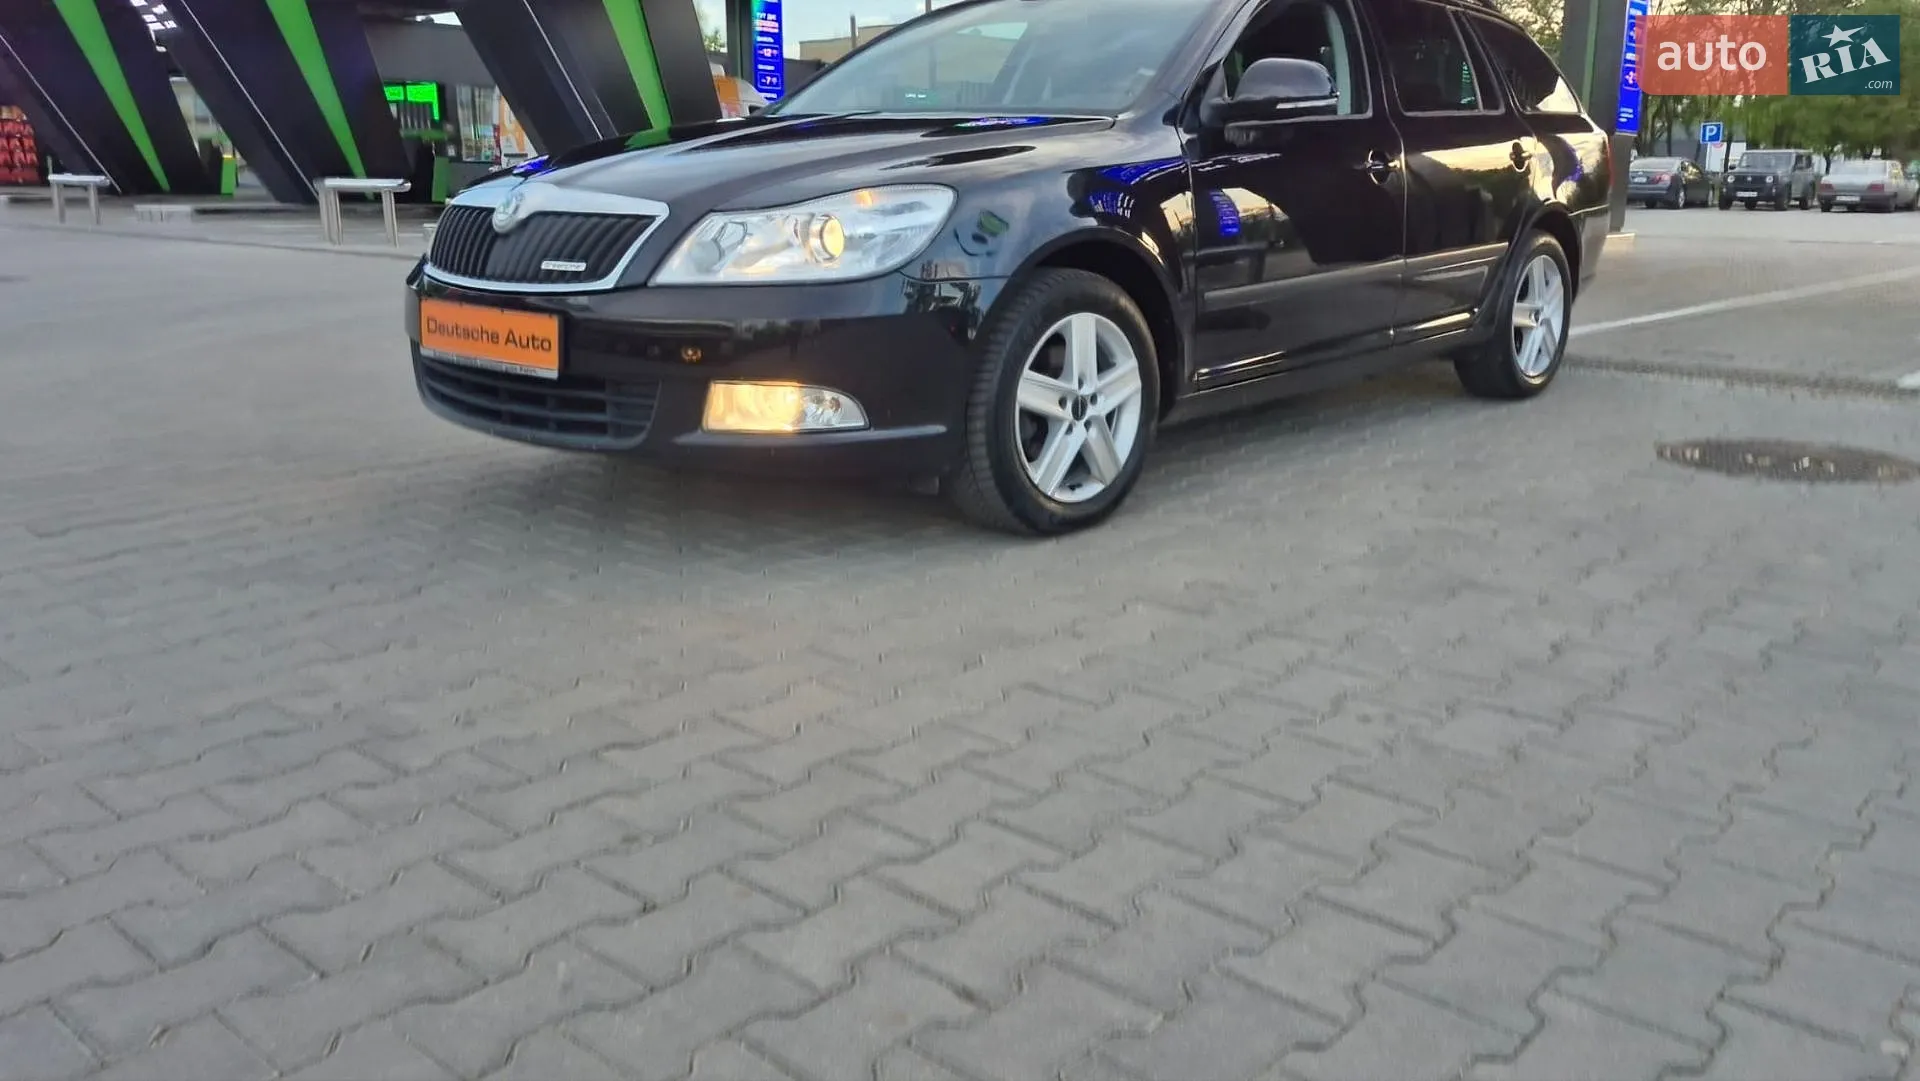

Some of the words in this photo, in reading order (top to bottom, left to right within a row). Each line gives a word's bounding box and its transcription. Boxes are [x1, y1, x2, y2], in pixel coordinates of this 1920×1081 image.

[1705, 125, 1718, 141] P
[427, 317, 500, 343] Deutsche
[505, 329, 551, 351] Auto
